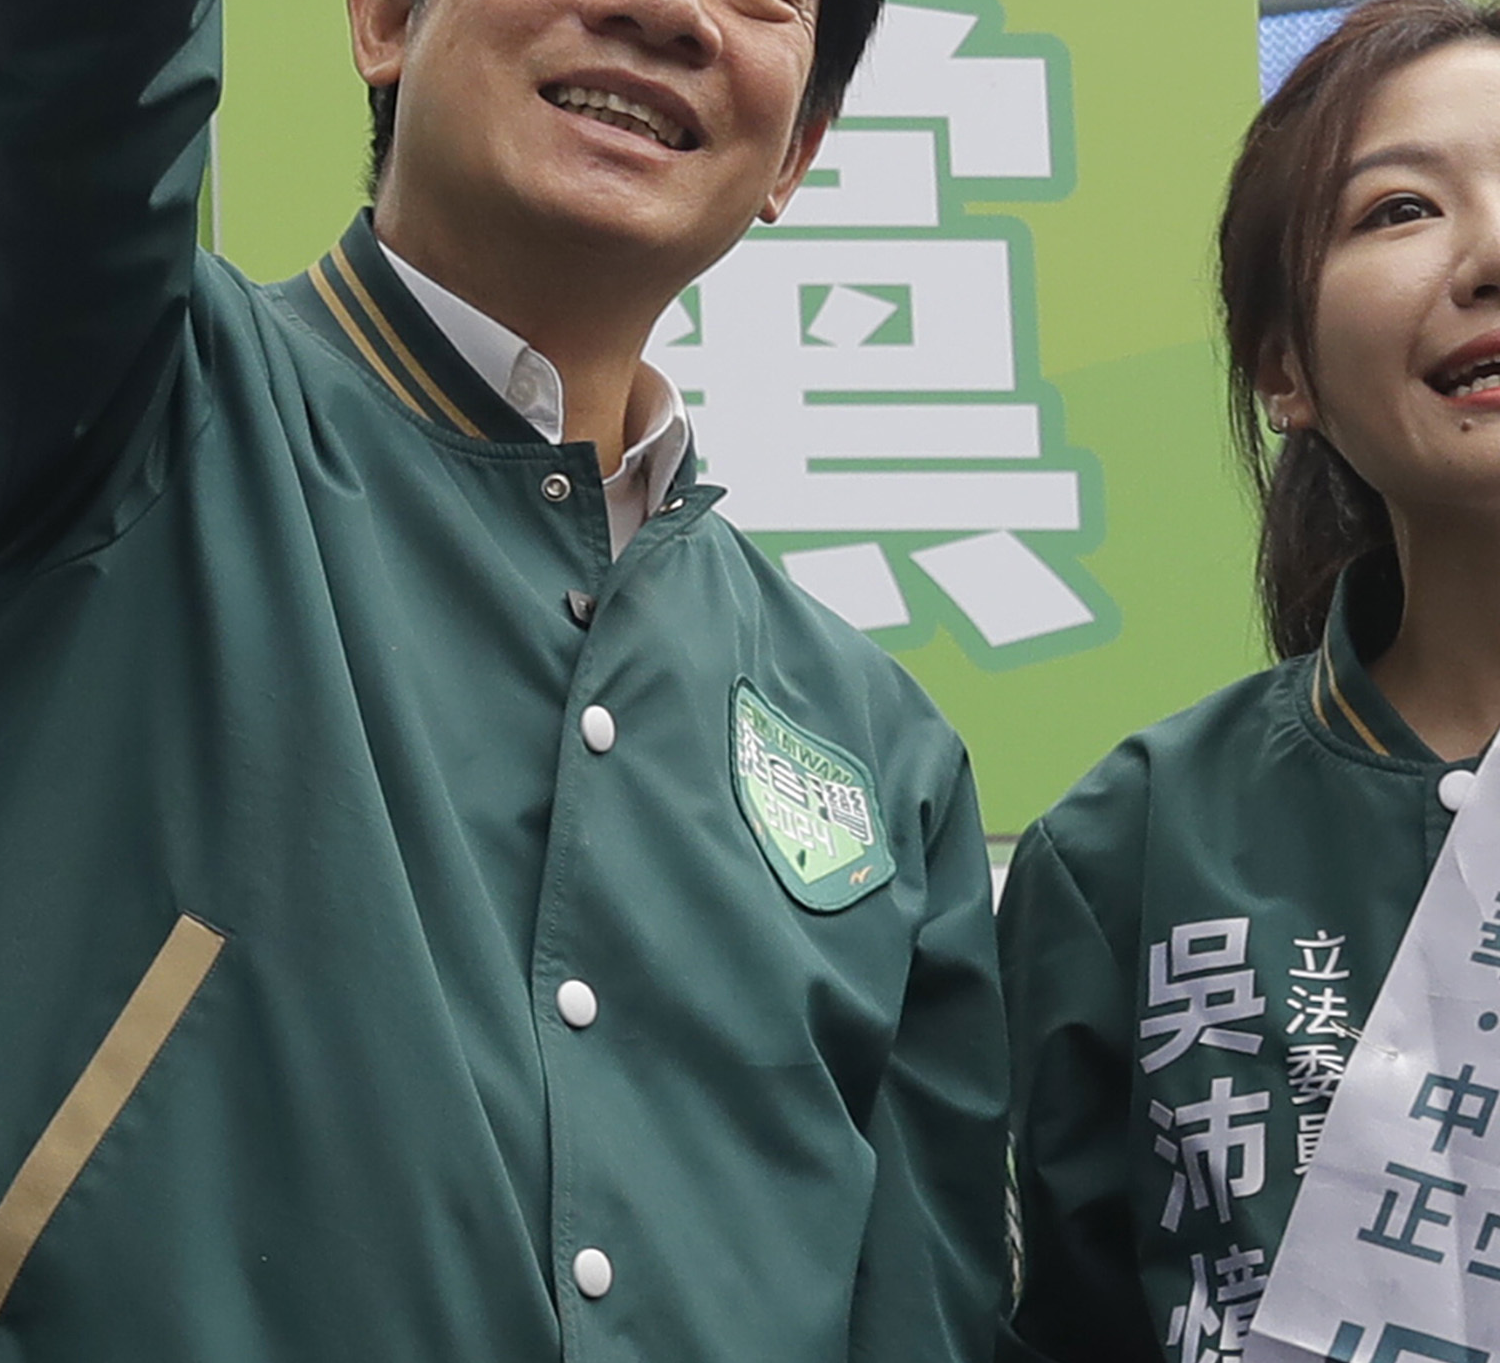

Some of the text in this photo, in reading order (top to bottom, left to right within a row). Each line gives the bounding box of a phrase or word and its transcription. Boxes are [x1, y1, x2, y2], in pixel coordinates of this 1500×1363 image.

[763, 791, 837, 857] 2024
[1285, 928, 1351, 1178] 立法委員
